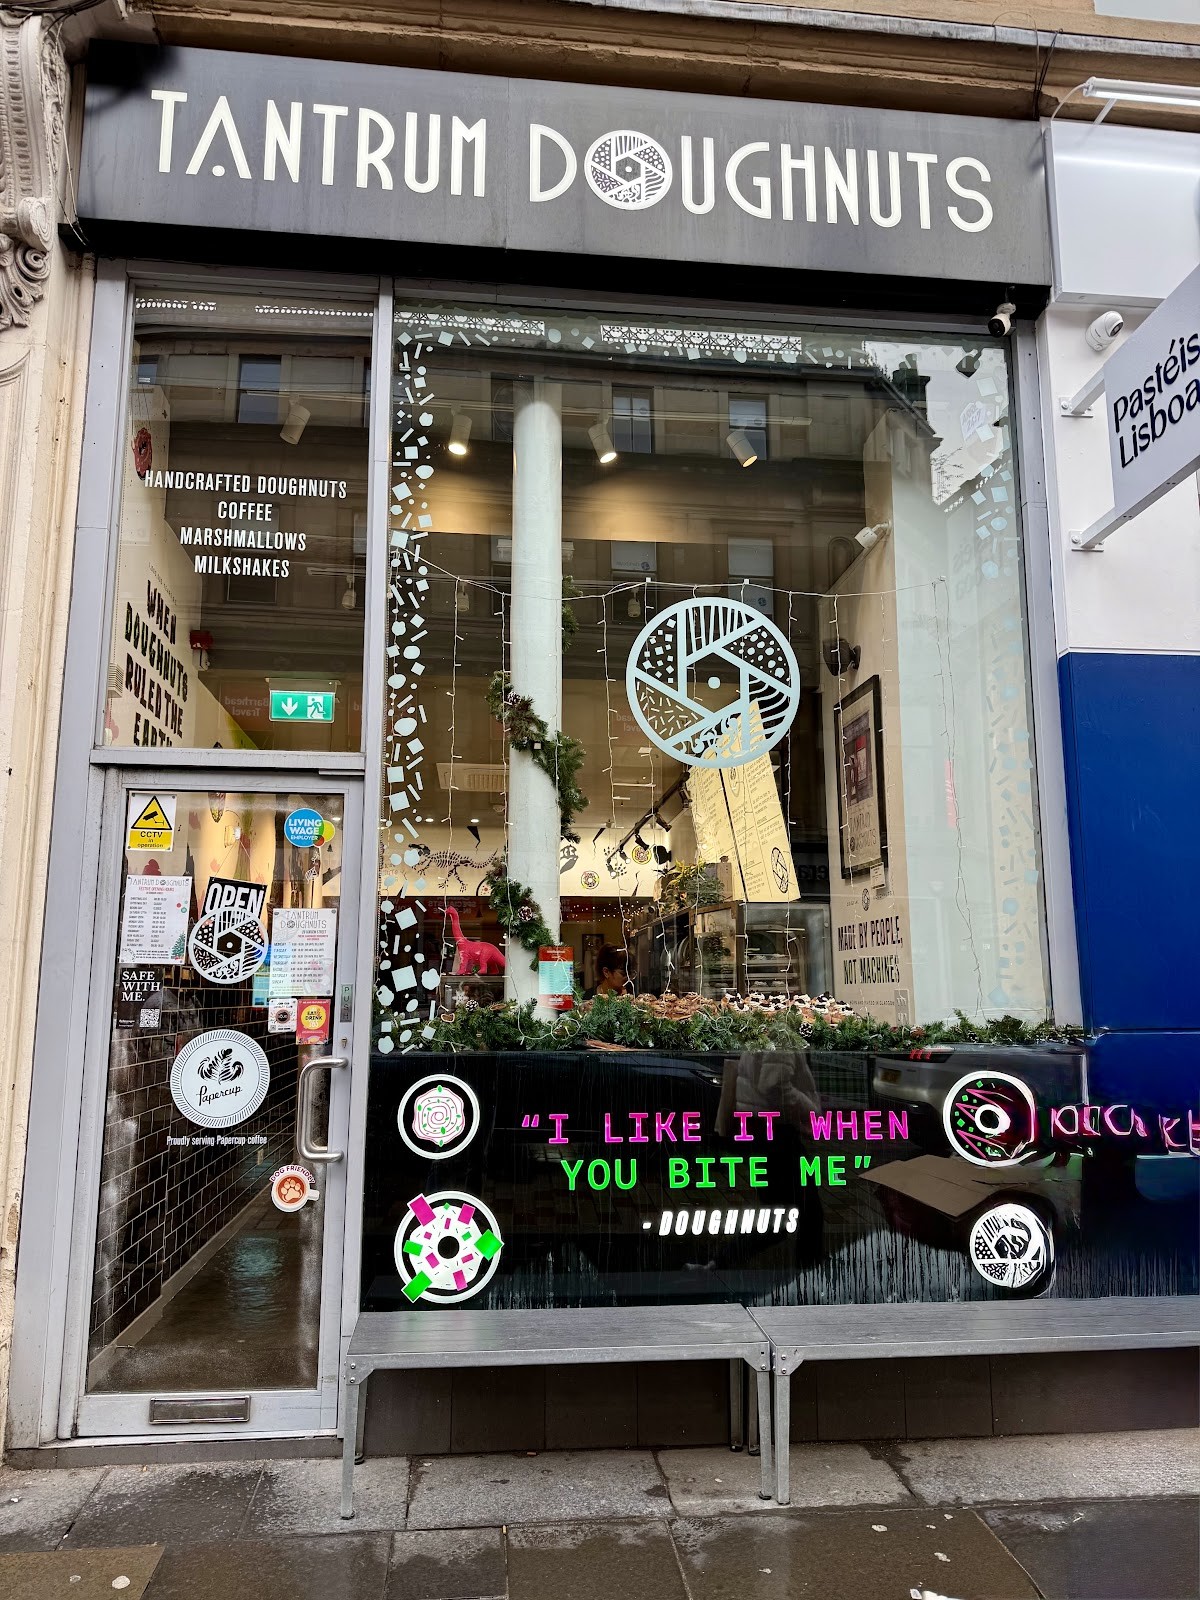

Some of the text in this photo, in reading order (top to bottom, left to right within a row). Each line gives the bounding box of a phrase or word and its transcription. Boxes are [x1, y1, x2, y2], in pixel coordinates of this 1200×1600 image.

[151, 89, 487, 198] TANTRUM
[1113, 332, 1200, 433] Pastéis
[1119, 378, 1200, 468] Lisboa
[144, 470, 347, 499] HANDCRAFTED DOUGHNUTS
[217, 501, 272, 522] COFFEE
[180, 526, 307, 551] MARSHMALLOWS
[194, 555, 290, 578] MILKSHAKES
[147, 580, 176, 645] WHEN
[125, 602, 188, 702] DOUGHNUTS
[164, 690, 183, 739] THE
[140, 830, 163, 838] CCTV
[288, 818, 322, 827] LIVING
[289, 826, 320, 835] WAGE
[204, 882, 265, 918] OPEN
[286, 910, 319, 920] TANTRUM
[837, 924, 857, 952] MADE
[858, 921, 868, 949] BY
[122, 970, 155, 980] SAFE
[843, 954, 900, 985] NOT MACHINES
[121, 981, 161, 991] WITH
[121, 991, 146, 1002] ME.
[166, 1134, 268, 1147] Proudly serving Papercup coffee
[603, 1111, 703, 1144] LIKE
[733, 1111, 782, 1142] IT
[810, 1110, 909, 1141] WHEN
[270, 1168, 285, 1182] DOG
[560, 1158, 637, 1191] YOU
[668, 1156, 769, 1190] BITE
[659, 1208, 800, 1237] DOUGHNUTS
